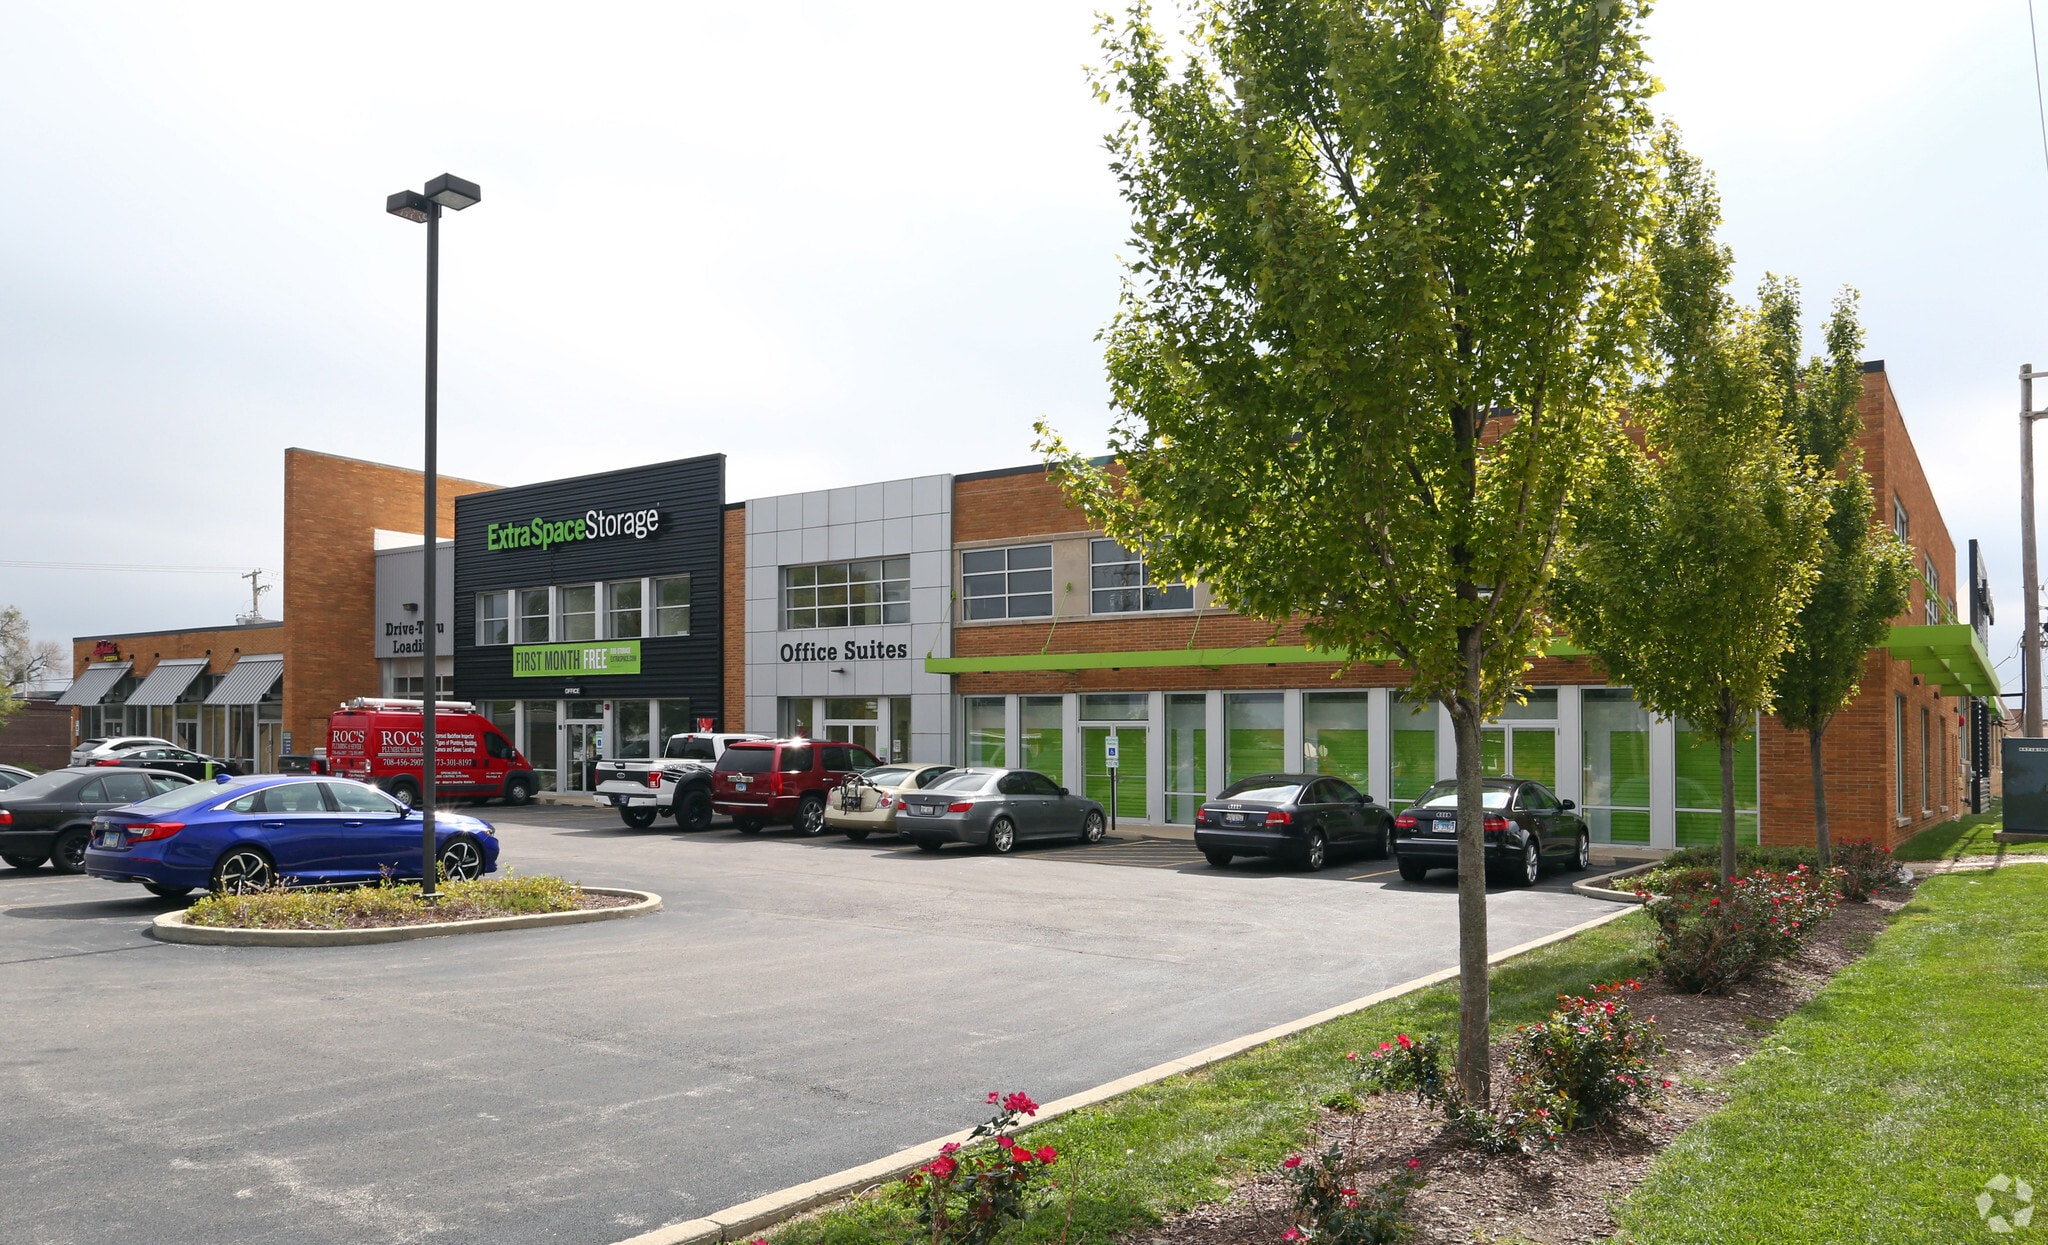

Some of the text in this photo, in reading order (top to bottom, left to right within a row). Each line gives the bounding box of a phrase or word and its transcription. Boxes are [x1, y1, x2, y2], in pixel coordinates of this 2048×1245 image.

[385, 620, 444, 636] Drive-Tu
[393, 639, 424, 653] Loadi
[780, 639, 907, 662] Office Suites
[516, 648, 608, 671] FIRST MONTH FREE
[332, 730, 365, 743] ROC'S
[383, 758, 424, 766] 708-456-2907
[435, 758, 472, 766] 73-301-8197
